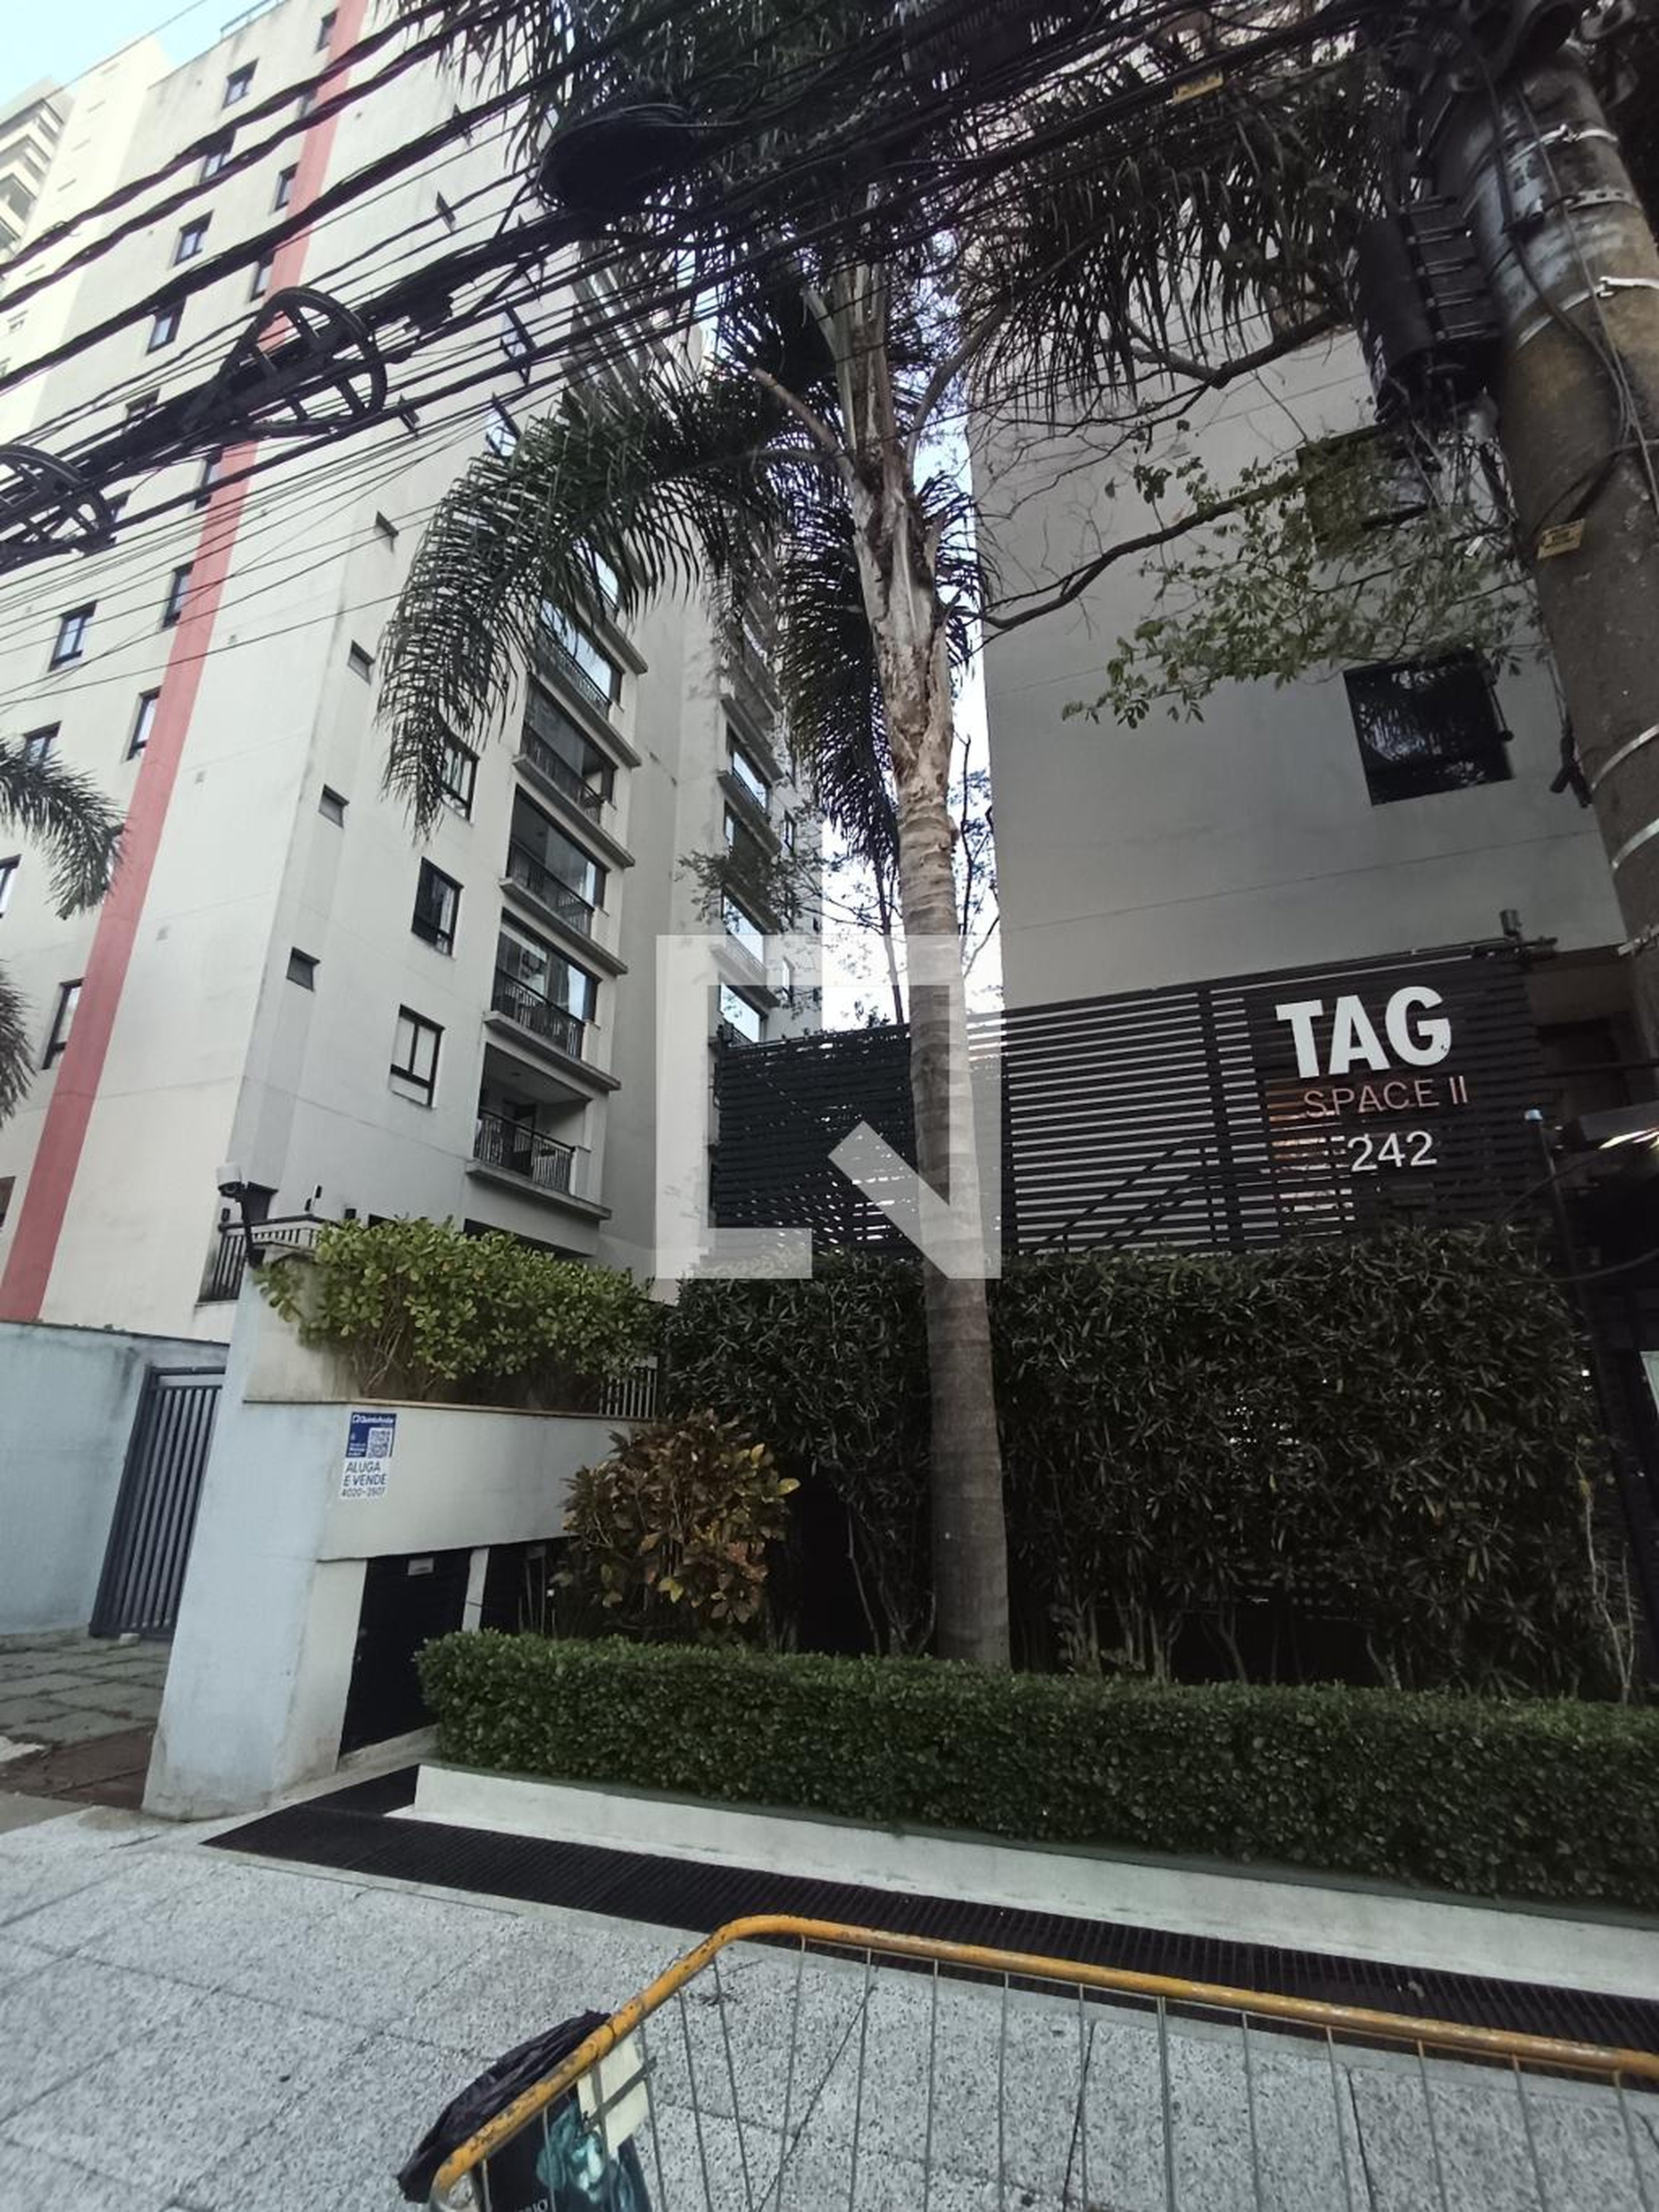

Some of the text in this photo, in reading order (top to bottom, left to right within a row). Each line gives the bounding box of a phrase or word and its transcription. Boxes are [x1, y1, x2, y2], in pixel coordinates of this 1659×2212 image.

[1275, 986, 1452, 1078] TAG
[1303, 1076, 1468, 1118] SPACE II
[1347, 1130, 1437, 1172] 242
[343, 1474, 387, 1486] E VENDE
[345, 1461, 381, 1473] ALUGA
